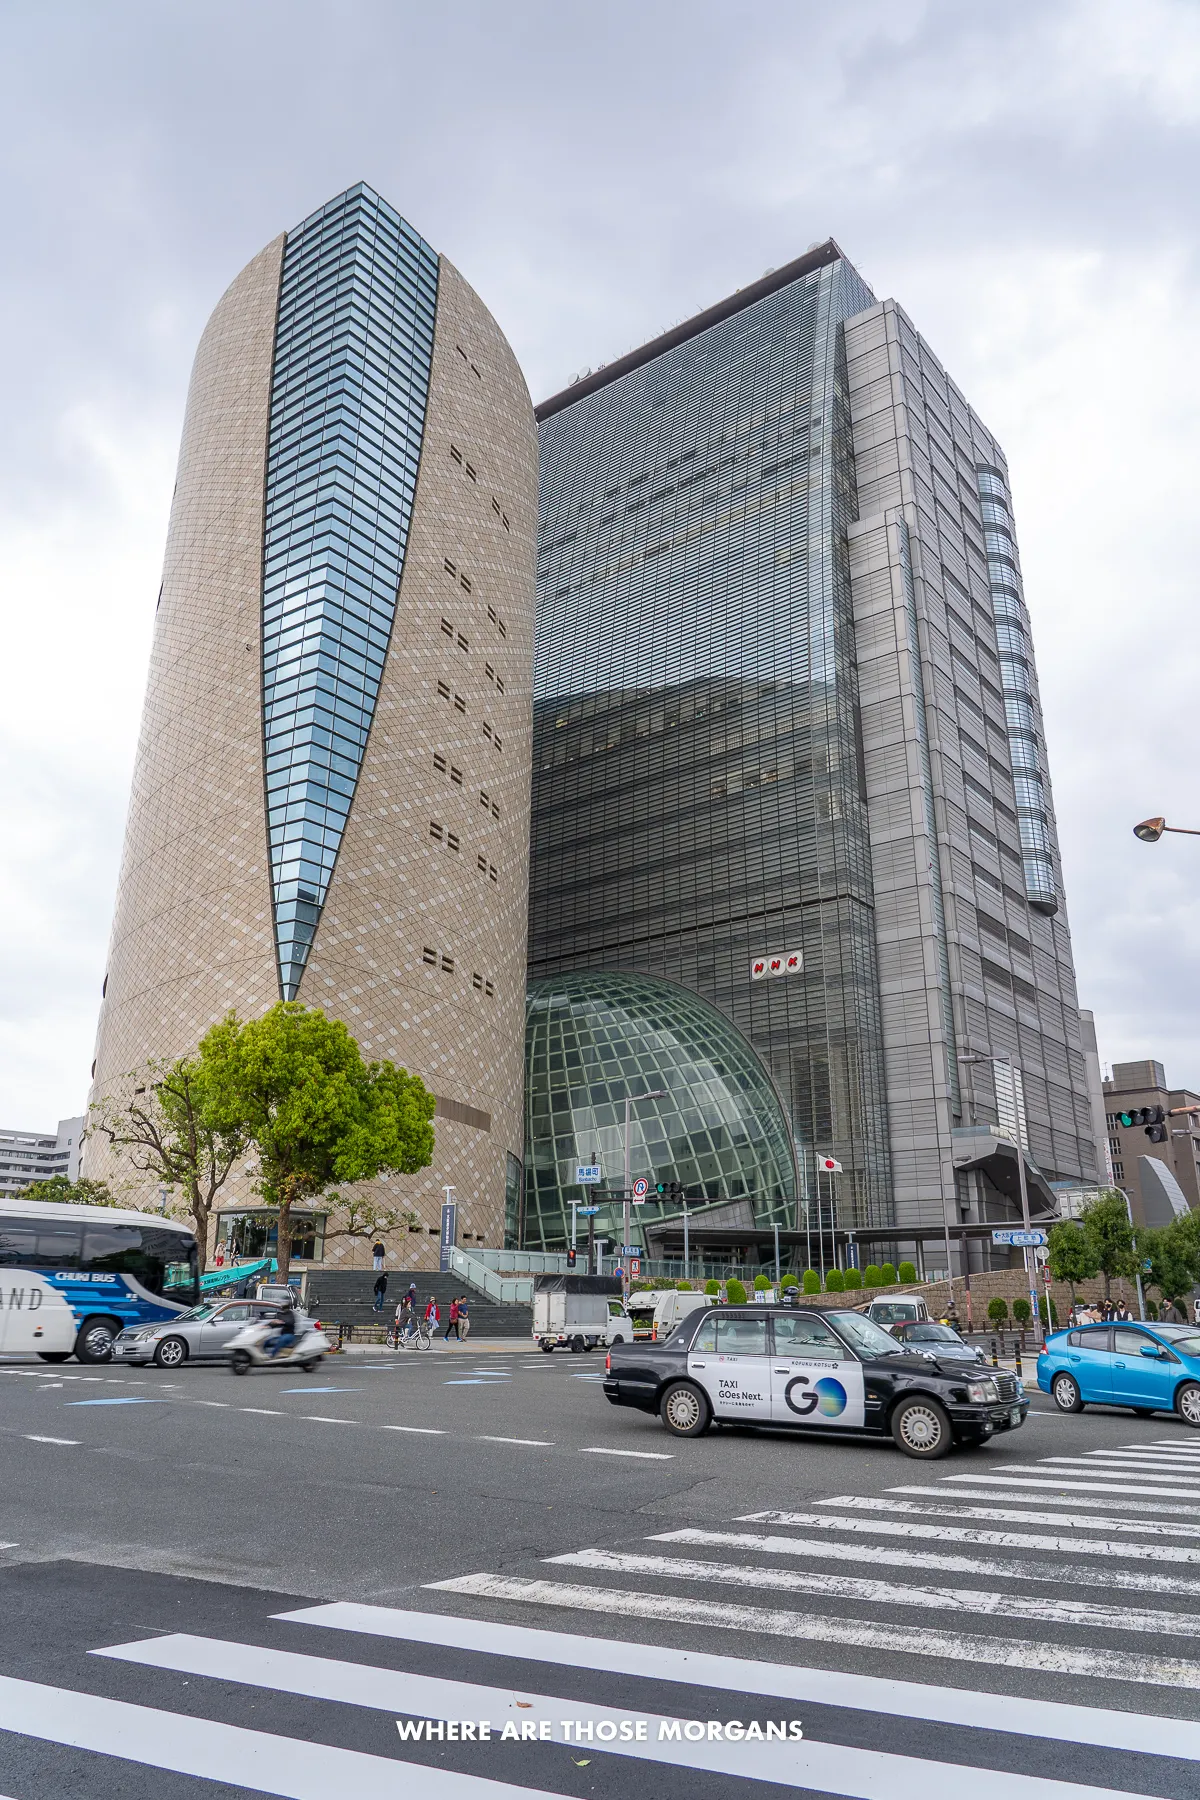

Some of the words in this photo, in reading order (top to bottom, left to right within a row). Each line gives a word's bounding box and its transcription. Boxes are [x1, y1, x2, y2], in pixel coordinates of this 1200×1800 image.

[754, 956, 798, 973] NHK
[578, 1167, 599, 1177] 馬場町
[91, 1274, 116, 1283] BUS
[0, 1287, 43, 1311] ND
[719, 1379, 738, 1389] TAXI
[718, 1390, 741, 1400] GOes
[742, 1391, 763, 1401] Next.
